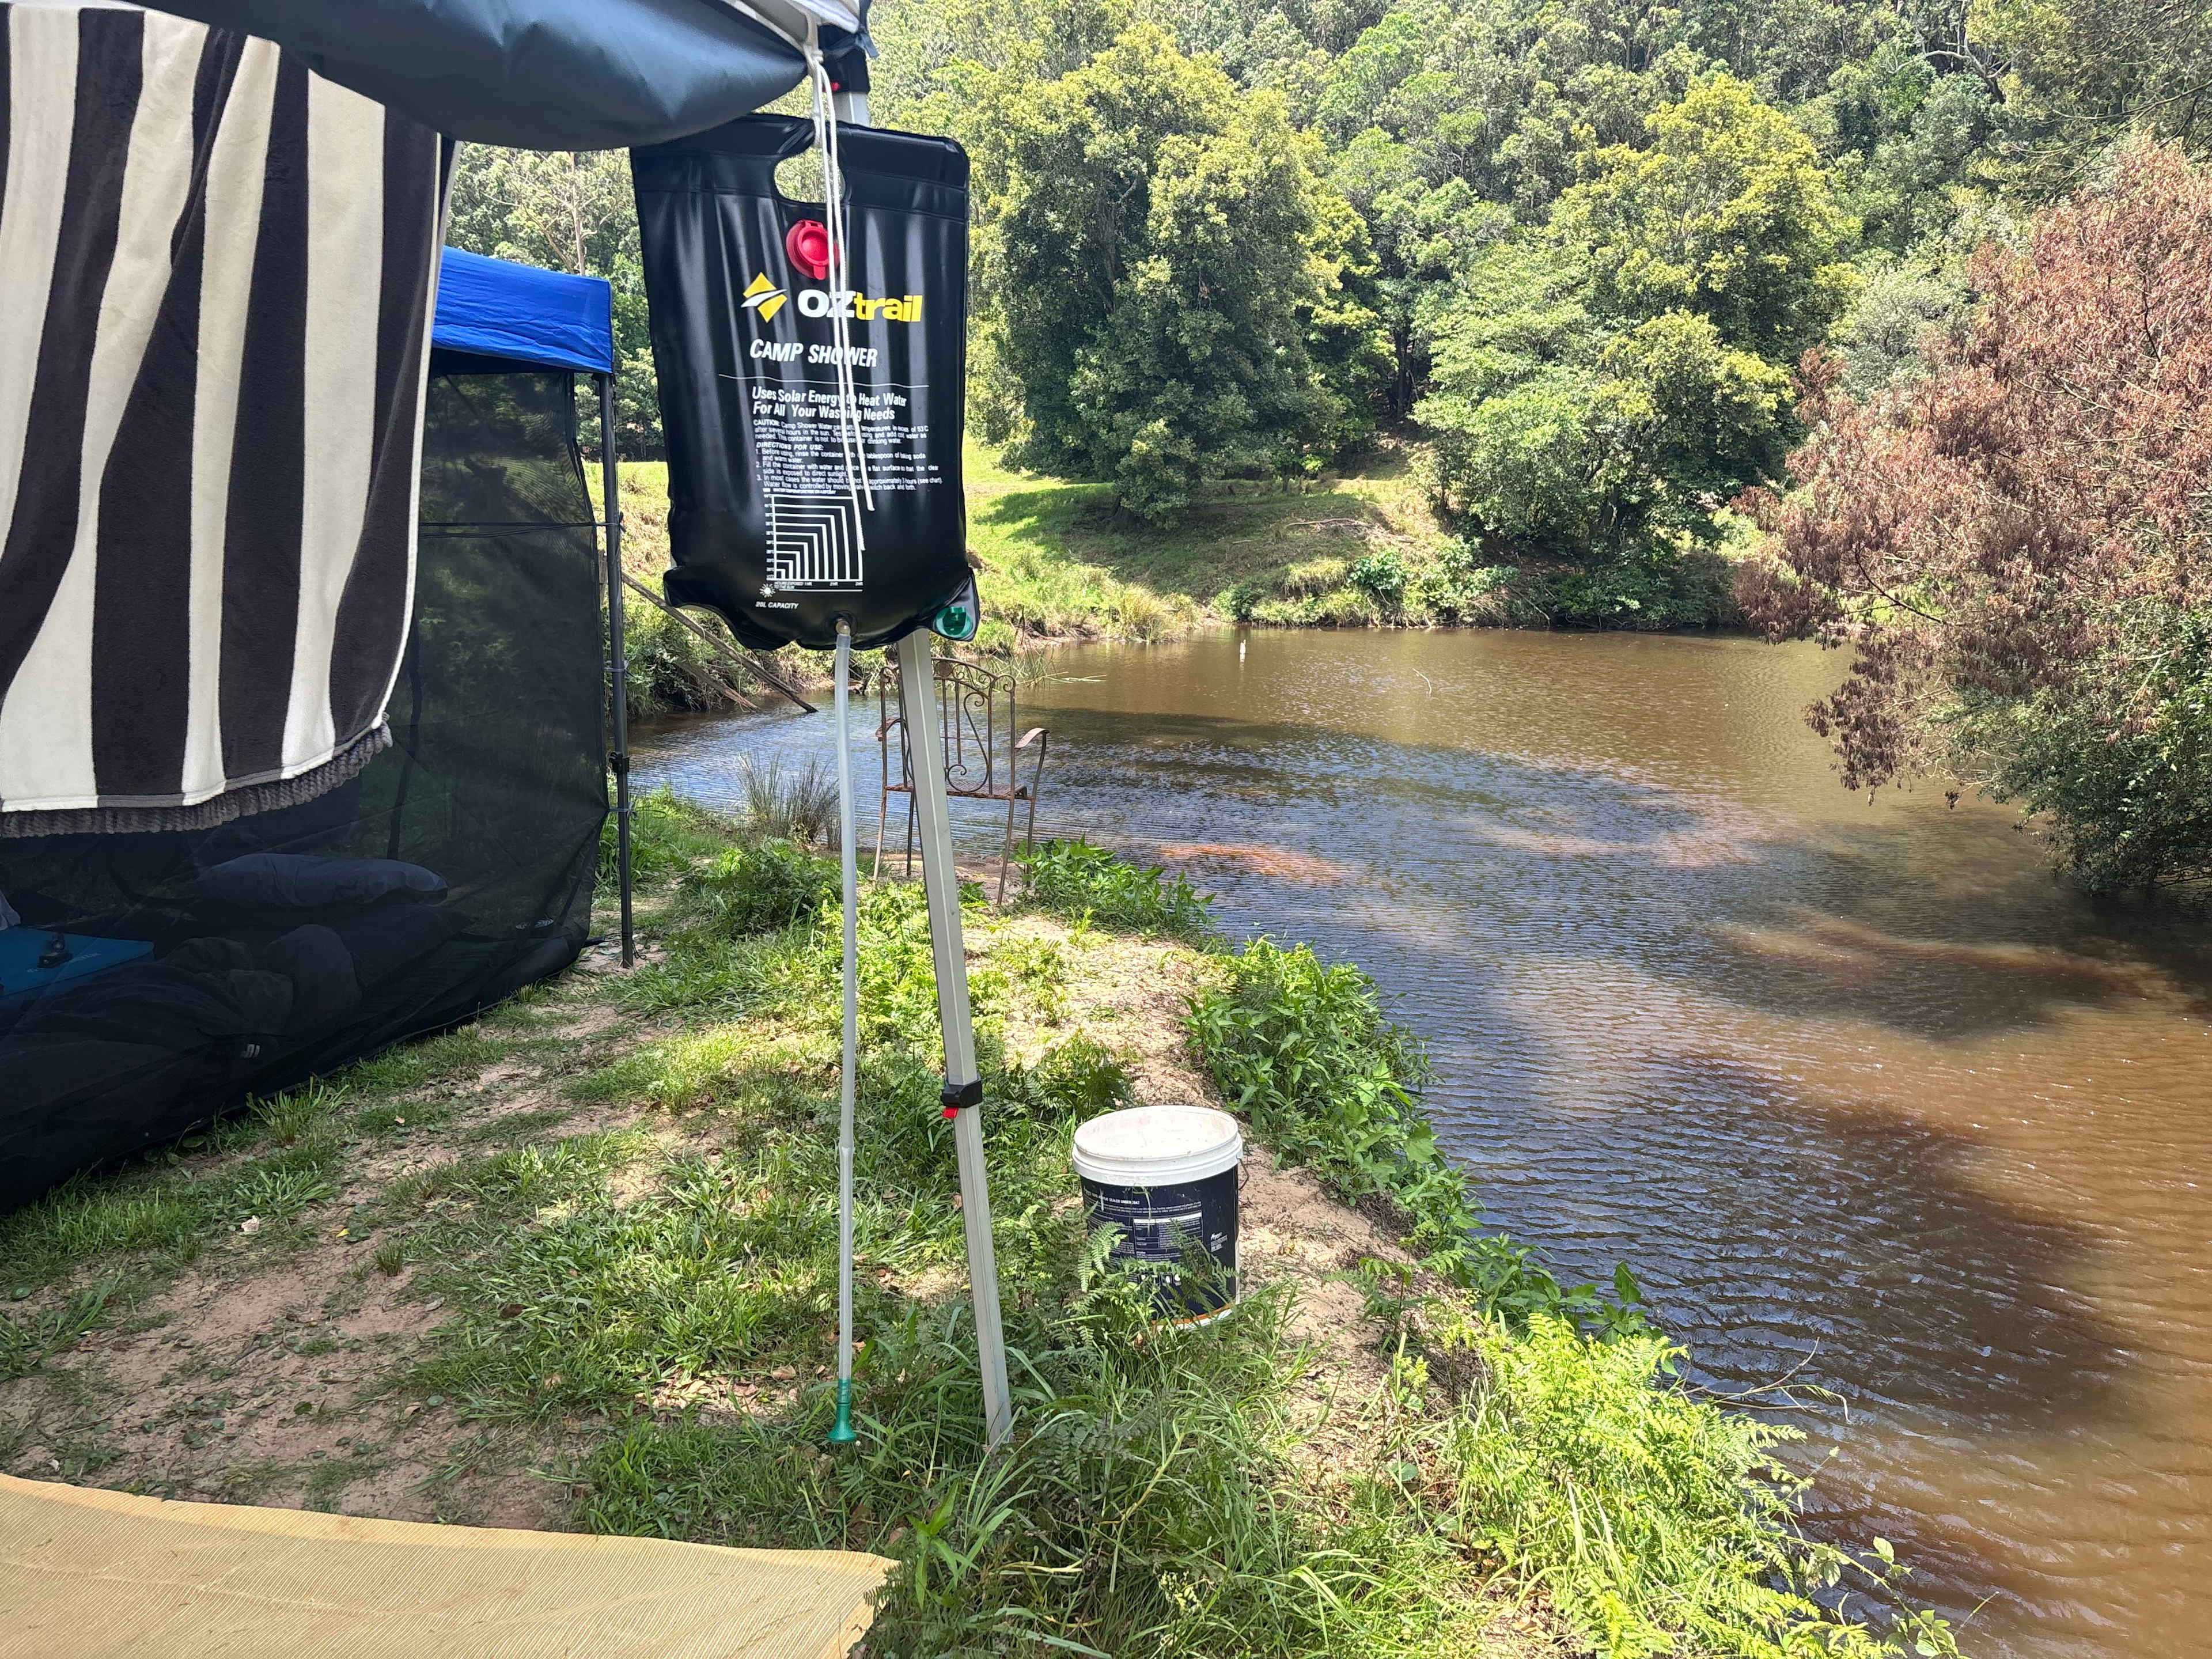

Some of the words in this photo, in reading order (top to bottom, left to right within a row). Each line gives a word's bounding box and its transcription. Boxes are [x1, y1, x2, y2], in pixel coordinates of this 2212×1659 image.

[797, 289, 923, 322] OZtrail
[750, 339, 804, 362] CAMP
[808, 344, 878, 368] SHOWER
[752, 387, 777, 400] Uses
[778, 389, 806, 402] Solar
[808, 390, 841, 407] Energy
[859, 392, 880, 406] Heat
[753, 401, 772, 414] For
[774, 403, 786, 416] All
[791, 404, 817, 417] Your
[819, 405, 862, 422] Wasig
[864, 407, 895, 421] Needs
[768, 601, 799, 609] CAPACITY
